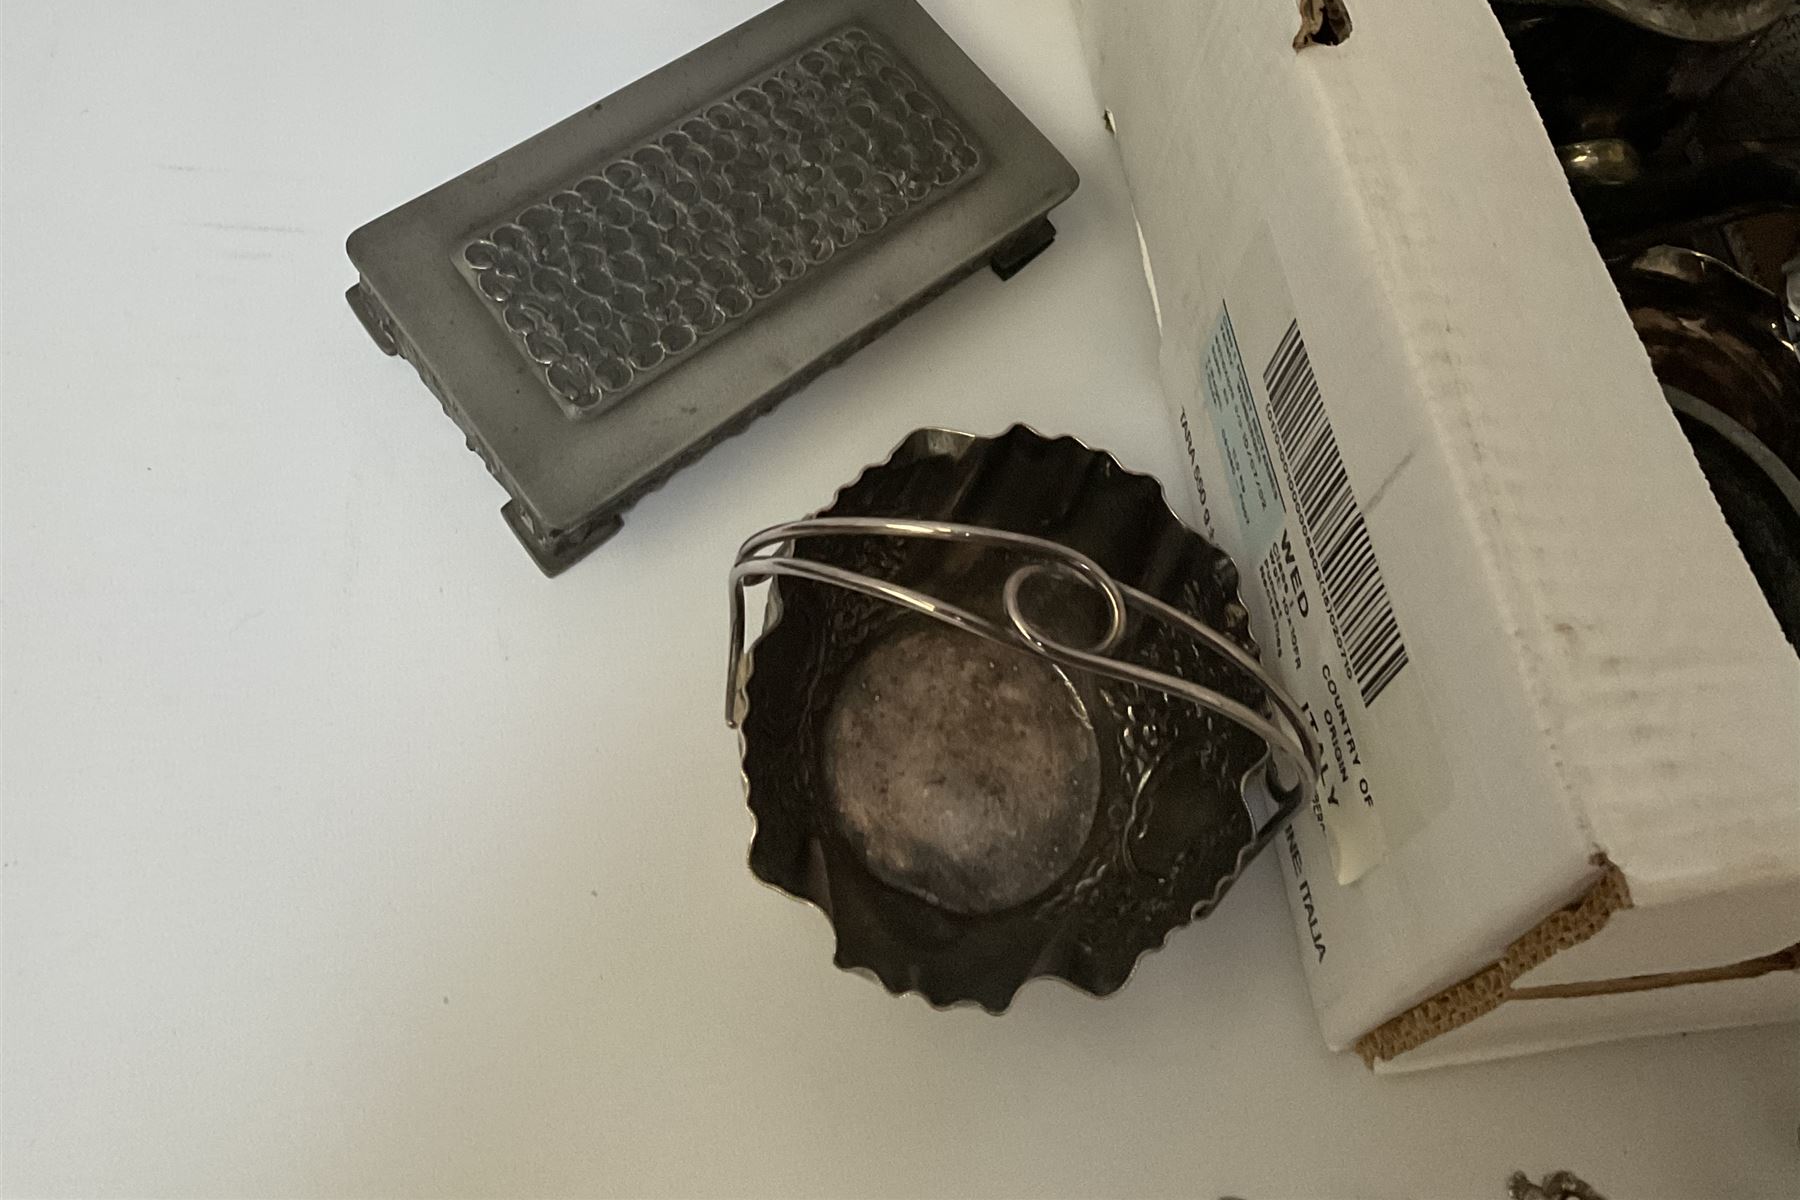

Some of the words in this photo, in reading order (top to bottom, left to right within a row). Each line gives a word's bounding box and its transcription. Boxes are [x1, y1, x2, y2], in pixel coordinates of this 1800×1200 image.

[1281, 528, 1309, 618] WED
[1321, 664, 1361, 766] COUNTRY
[1359, 777, 1374, 809] OF
[1324, 709, 1349, 783] ORIGIN
[1300, 880, 1327, 965] ITALIA
